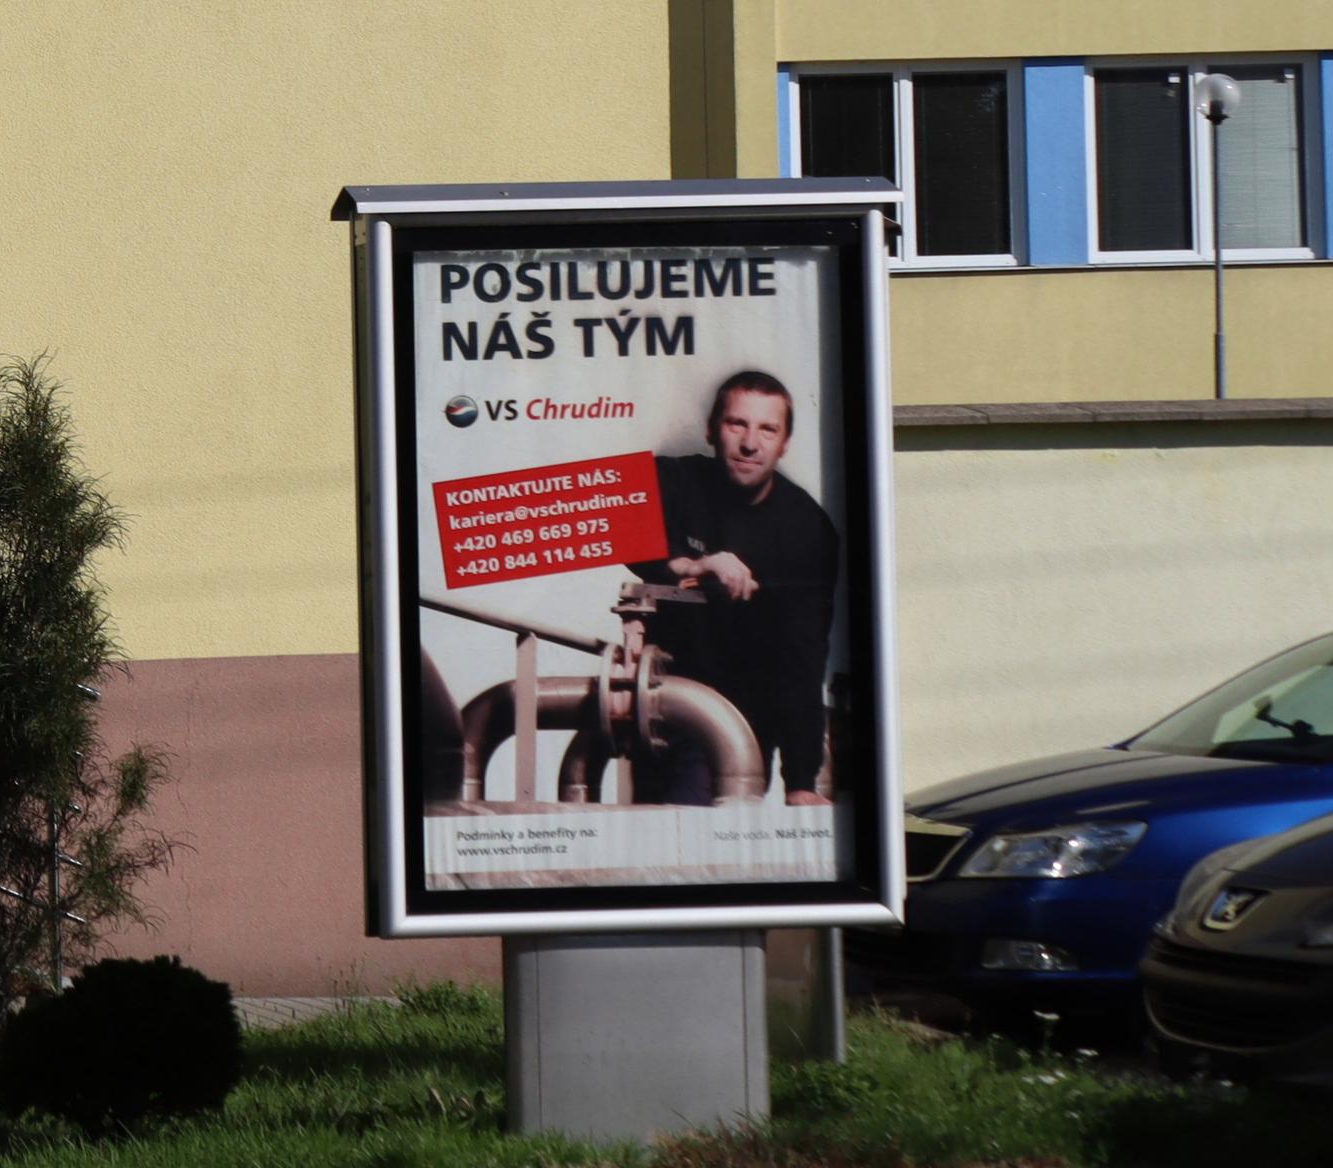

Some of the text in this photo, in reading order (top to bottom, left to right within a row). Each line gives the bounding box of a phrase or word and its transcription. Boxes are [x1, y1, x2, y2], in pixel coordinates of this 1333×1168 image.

[440, 257, 777, 304] POSILUJEME
[442, 308, 695, 361] NÁŠ TÝM
[485, 396, 634, 421] VS Chrudim
[445, 468, 621, 506] KONTAKTUJTE NÁS:
[449, 491, 647, 530] kariera@vschrudim.cz
[453, 518, 610, 553] +420 469 669 975
[456, 541, 613, 576] +420 844 114 455
[457, 844, 568, 857] www.vschrudim.cz
[517, 831, 525, 839] a
[528, 827, 576, 840] benefity
